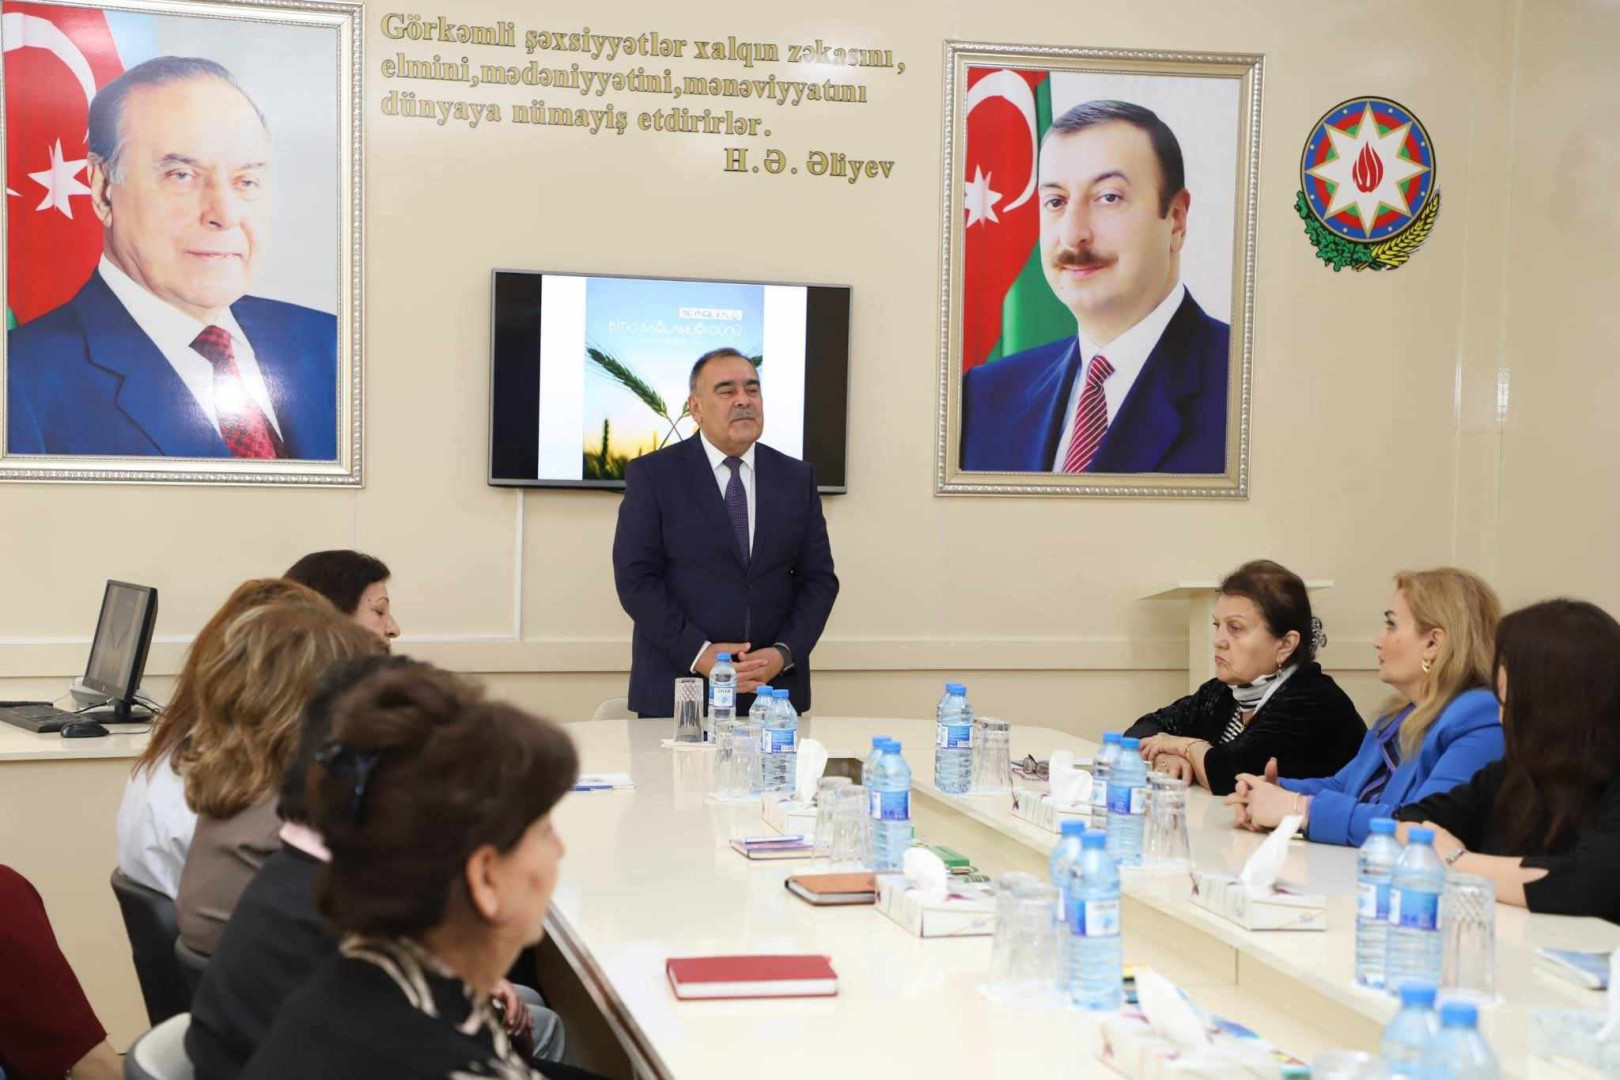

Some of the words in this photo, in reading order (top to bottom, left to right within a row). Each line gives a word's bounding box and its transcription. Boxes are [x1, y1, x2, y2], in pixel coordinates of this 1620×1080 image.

[380, 13, 516, 48] Görkəmli
[525, 26, 688, 62] şəxsiyyətlər
[694, 36, 780, 69] xalqın
[380, 90, 502, 129] dünyaya
[512, 100, 628, 136] nümayiş
[638, 107, 772, 138] etdirirlər.
[806, 150, 896, 185] Əliyev
